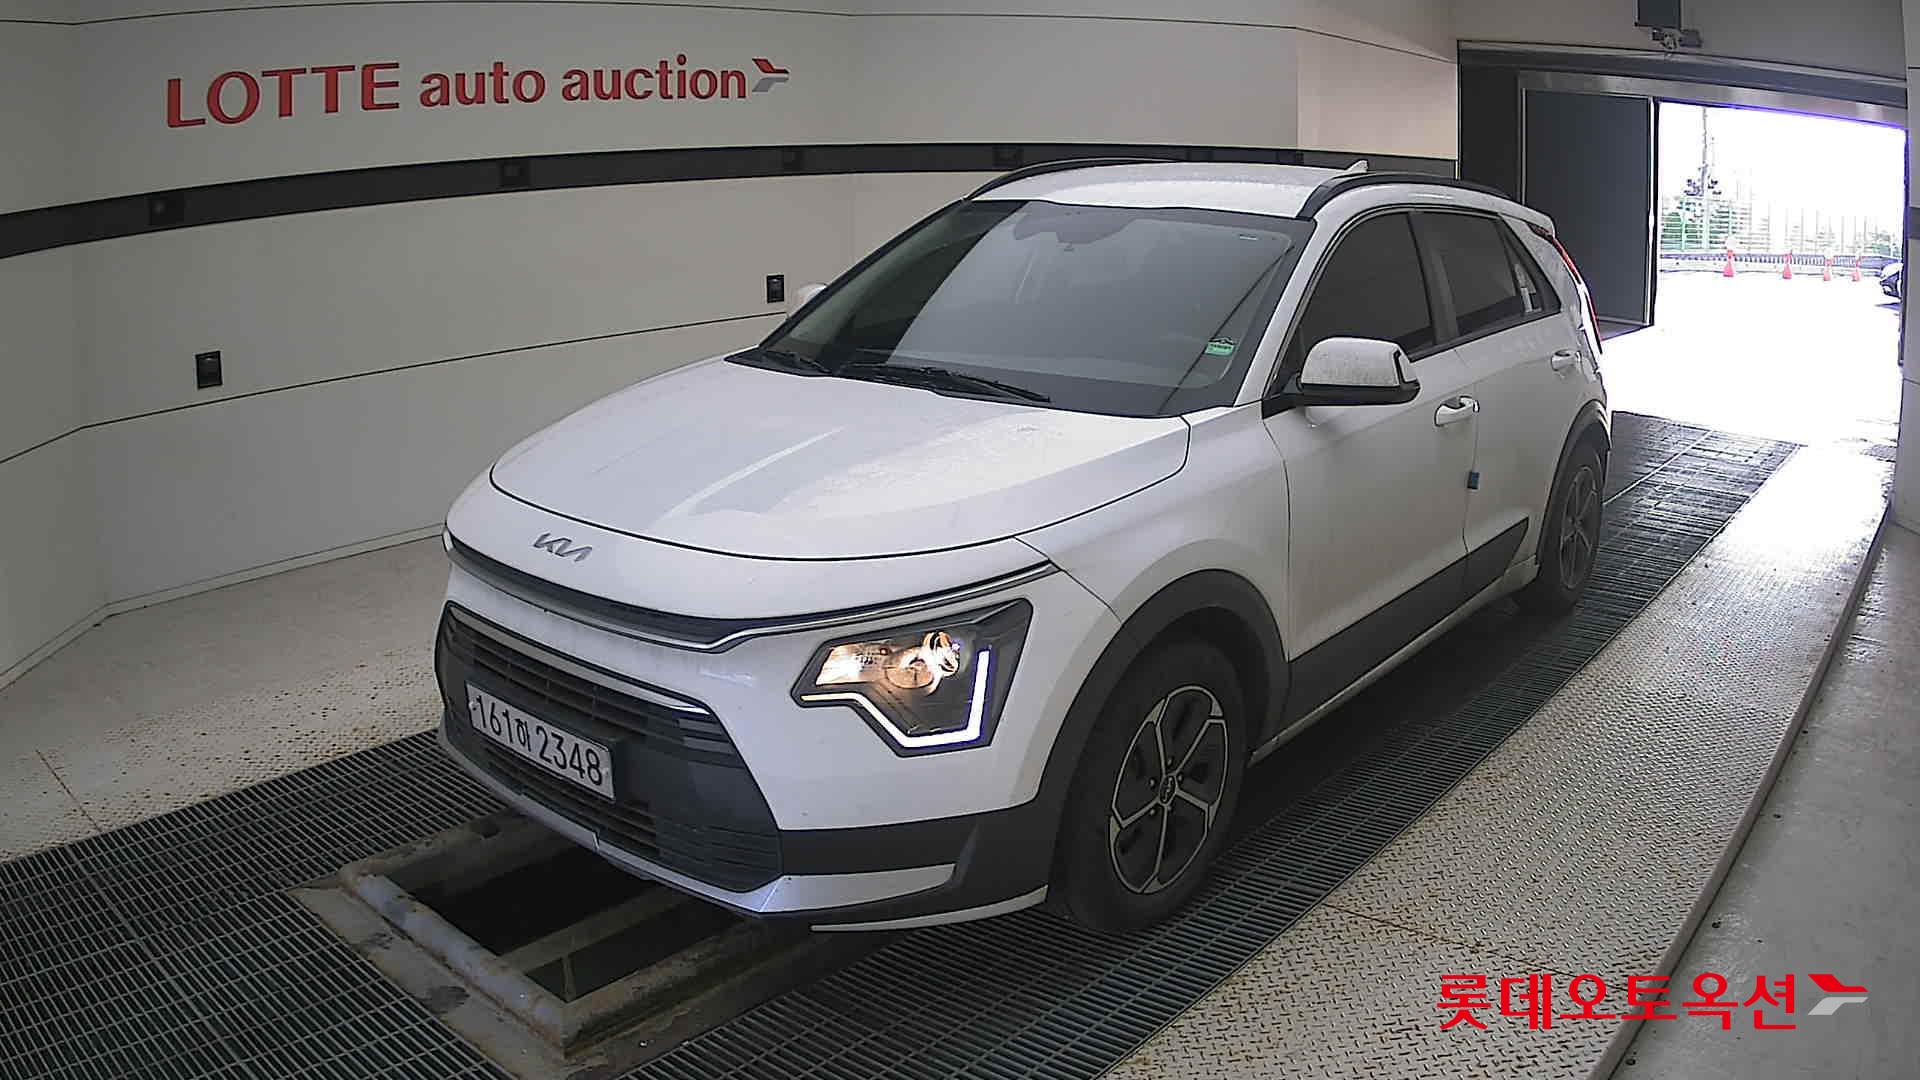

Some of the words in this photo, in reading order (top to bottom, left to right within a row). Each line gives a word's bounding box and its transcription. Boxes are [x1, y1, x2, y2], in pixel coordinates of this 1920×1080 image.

[166, 62, 400, 128] LOTTE
[419, 61, 547, 108] auto
[561, 53, 747, 102] auction
